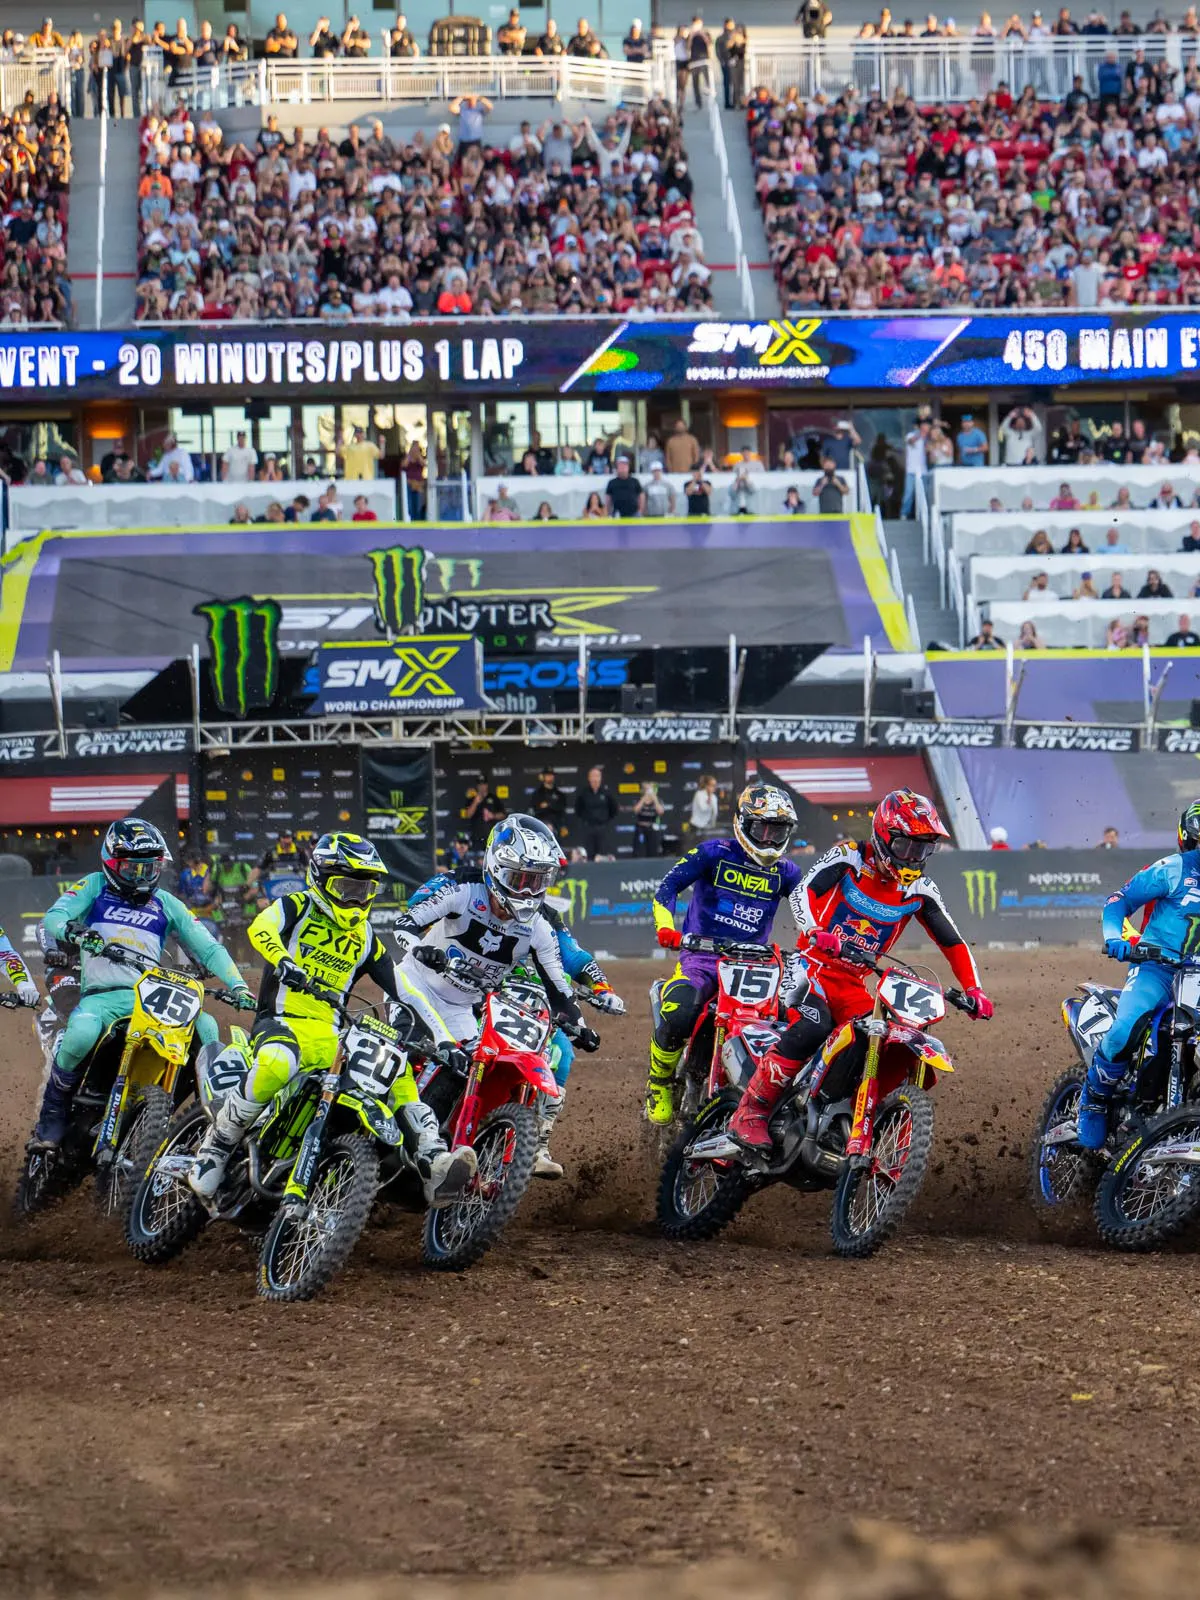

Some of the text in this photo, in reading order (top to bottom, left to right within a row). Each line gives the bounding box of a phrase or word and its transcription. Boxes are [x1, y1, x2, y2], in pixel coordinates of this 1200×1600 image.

[687, 319, 822, 365] SMX
[1002, 329, 1067, 371] 450
[1079, 327, 1168, 370] MAIN
[118, 344, 162, 385] 20
[174, 339, 424, 385] MINUTES/PLUS
[434, 339, 450, 381] 1
[462, 338, 524, 380] LAP
[415, 600, 554, 634] ONSTER
[323, 646, 460, 697] SMX
[324, 697, 464, 712] WORLD CHAMPIONSHIP
[95, 729, 186, 742] ROCKY MOUNTAIN
[620, 717, 712, 729] ROCKY MOUNTAIN
[765, 719, 857, 732] ROCKY MOUNTAIN
[723, 869, 773, 894] O'NEAL
[103, 906, 159, 927] LEATT
[714, 913, 759, 934] HONDA
[734, 903, 764, 918] QUAD
[299, 923, 362, 961] FXR
[311, 955, 351, 974] RACING
[314, 950, 354, 969] TRIUMPH
[730, 968, 773, 999] 15
[143, 986, 195, 1023] 45
[891, 981, 937, 1021] 14
[1077, 1011, 1111, 1035] 1
[207, 1059, 248, 1091] 20
[350, 1038, 402, 1088] 20
[105, 1091, 122, 1143] DUNLOP
[1114, 1136, 1143, 1174] DUNLOP
